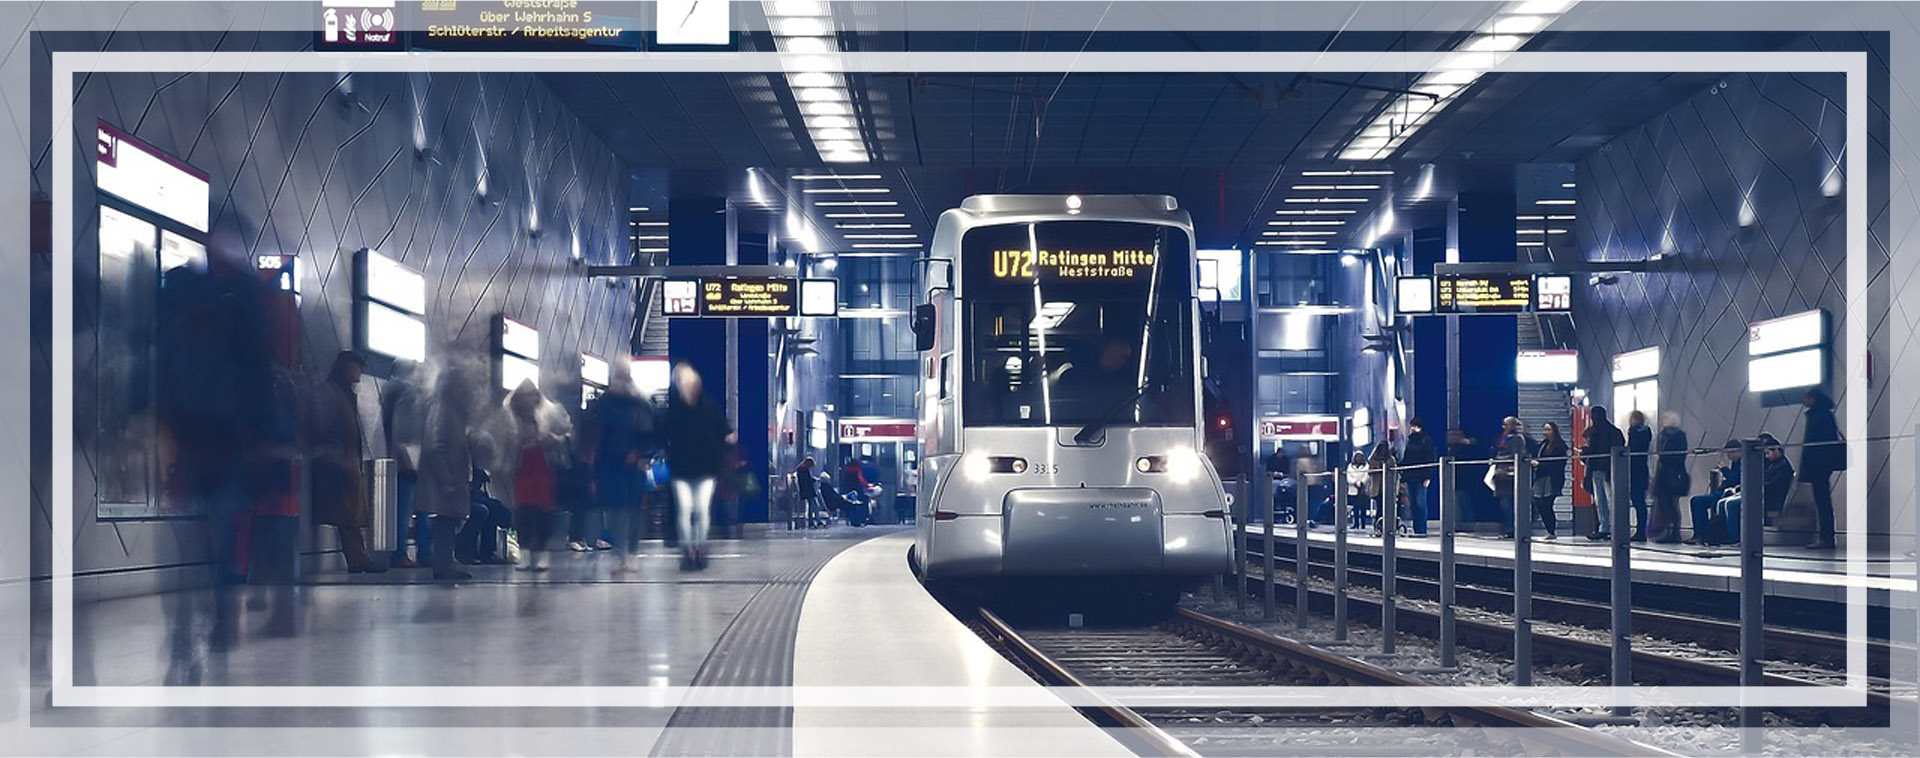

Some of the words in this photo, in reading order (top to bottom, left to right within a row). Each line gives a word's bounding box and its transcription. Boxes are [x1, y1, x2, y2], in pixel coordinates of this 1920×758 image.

[480, 12, 510, 23] über
[515, 12, 579, 23] Wehrhahn
[583, 12, 592, 23] S
[364, 33, 390, 42] Notruf
[428, 25, 507, 37] Schlüterstr.
[511, 27, 520, 36] /
[524, 26, 622, 39] Arbeitsagentur
[258, 255, 282, 269] SOS
[993, 251, 1033, 277] U72
[1038, 251, 1106, 266] Ratingen
[1113, 250, 1154, 265] Mitte
[1059, 266, 1133, 277] Weststraße
[705, 283, 722, 291] U72
